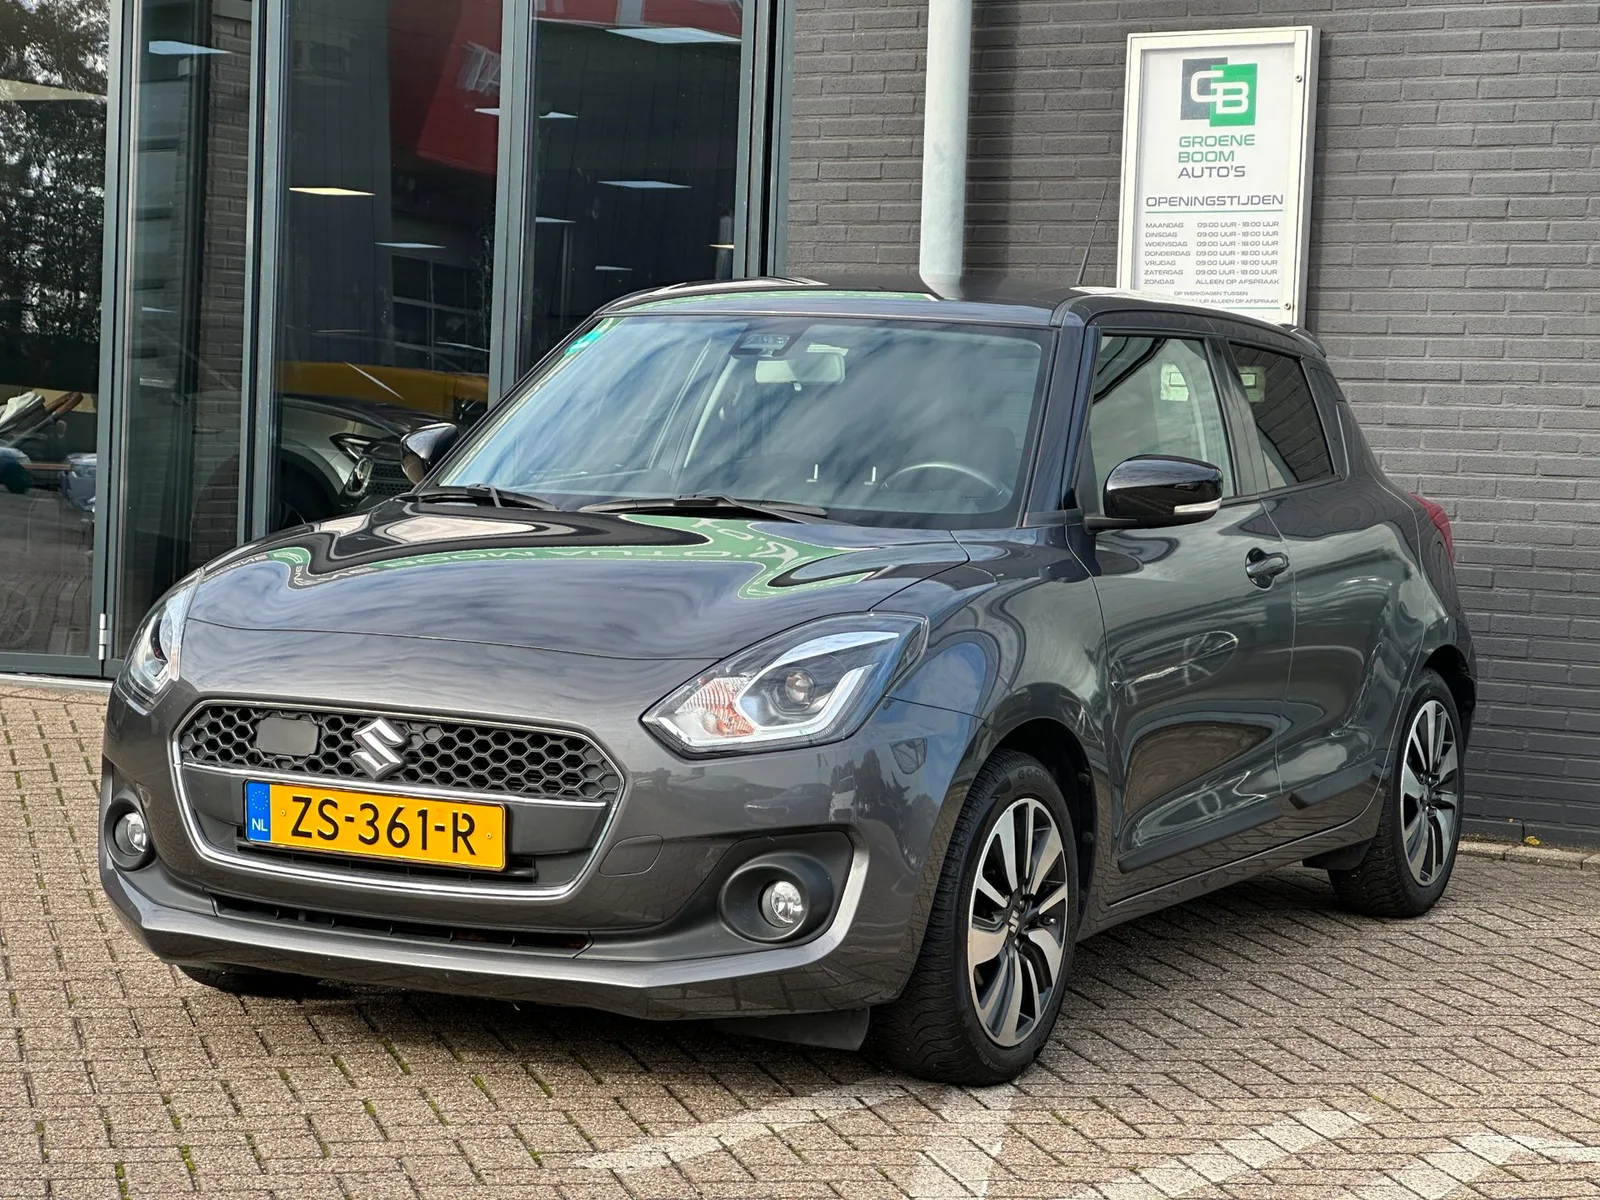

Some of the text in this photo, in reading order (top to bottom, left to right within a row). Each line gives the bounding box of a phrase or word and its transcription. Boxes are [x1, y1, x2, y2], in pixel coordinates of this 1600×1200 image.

[1179, 134, 1255, 148] GROENE
[1177, 150, 1235, 163] BOOM
[1177, 165, 1246, 179] AUTO'S
[1145, 194, 1284, 207] OPENINGSTIJDEN
[251, 817, 268, 832] NL
[291, 795, 477, 856] ZS-361-R
